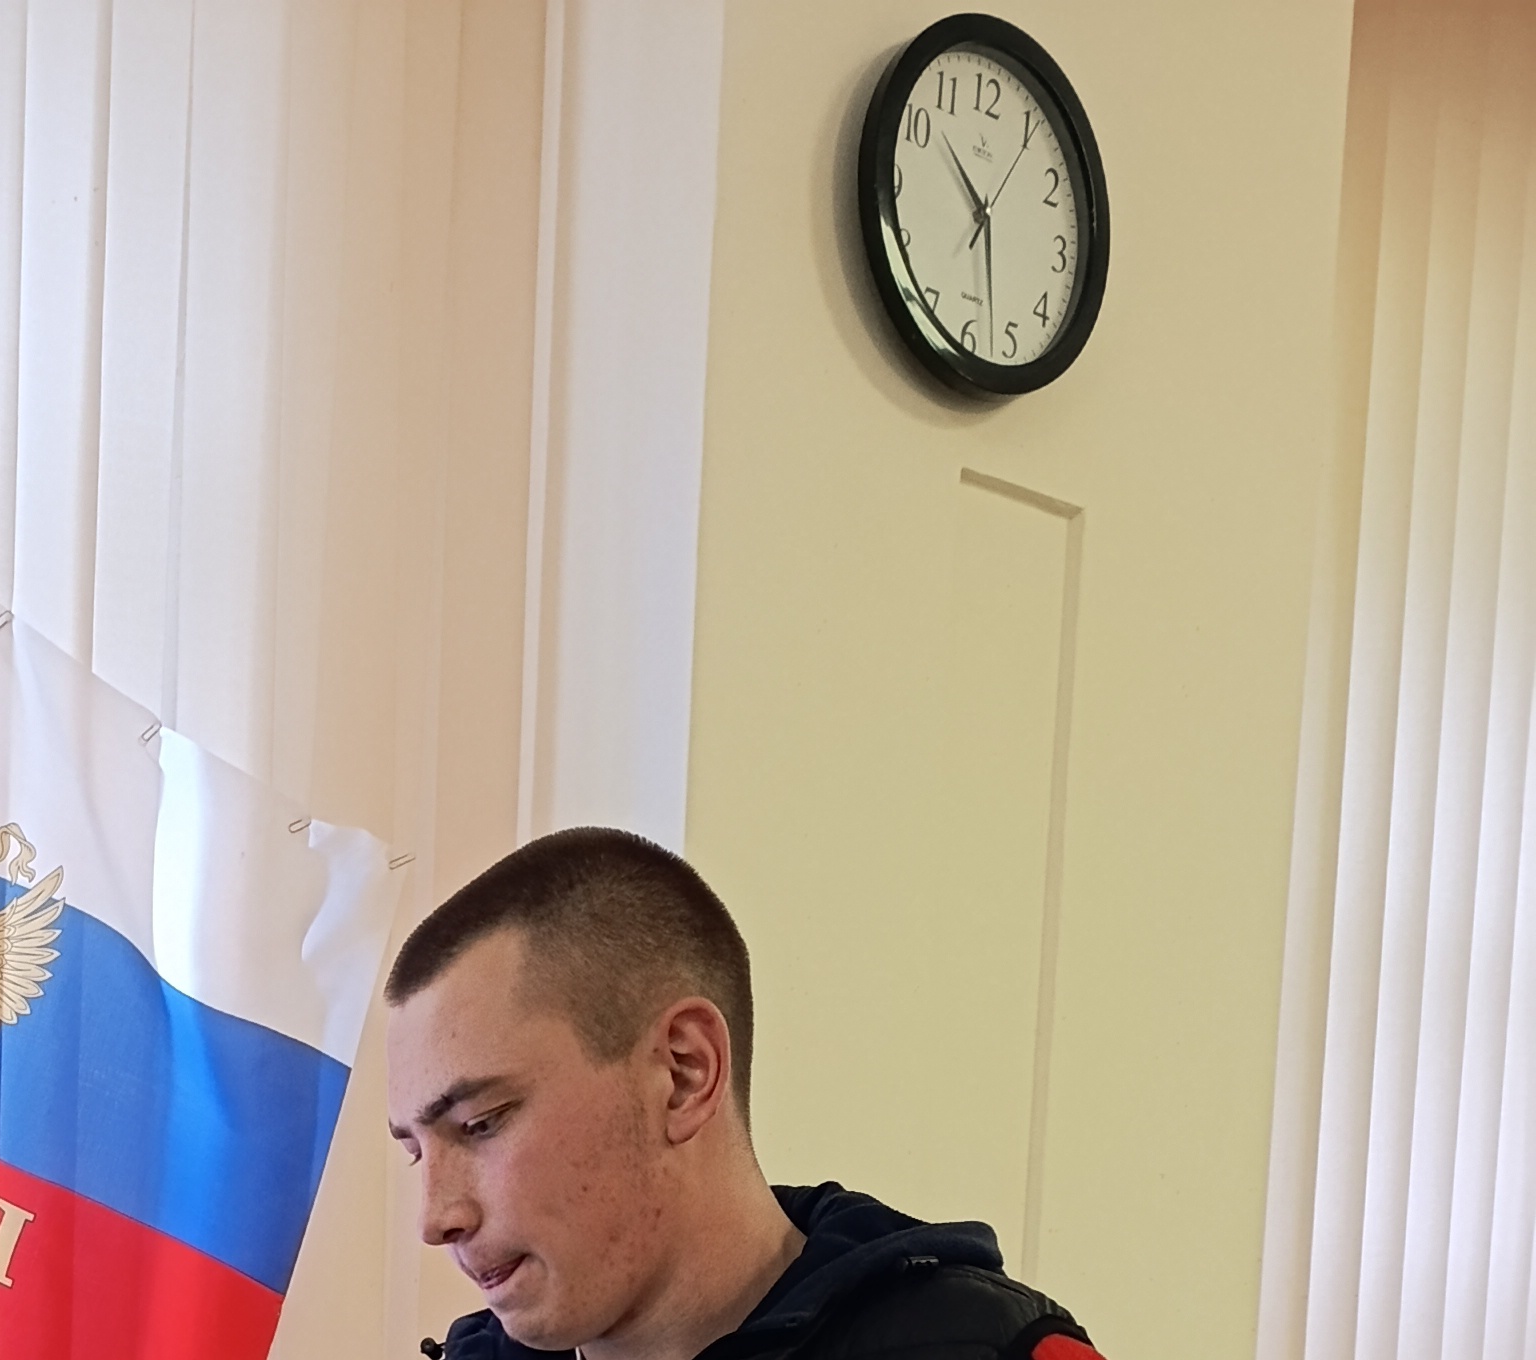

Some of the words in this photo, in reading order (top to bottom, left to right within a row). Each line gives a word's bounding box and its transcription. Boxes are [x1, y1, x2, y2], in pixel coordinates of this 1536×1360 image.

[936, 70, 957, 117] 11
[973, 72, 1001, 120] 12
[905, 103, 931, 149] 10
[1021, 110, 1032, 150] 1
[1042, 167, 1059, 208] 2
[1051, 234, 1067, 273] 3
[924, 286, 941, 314] 7
[960, 291, 984, 307] QUARTZ
[1033, 291, 1050, 328] 4
[960, 319, 977, 355] 6
[1001, 321, 1019, 359] 5
